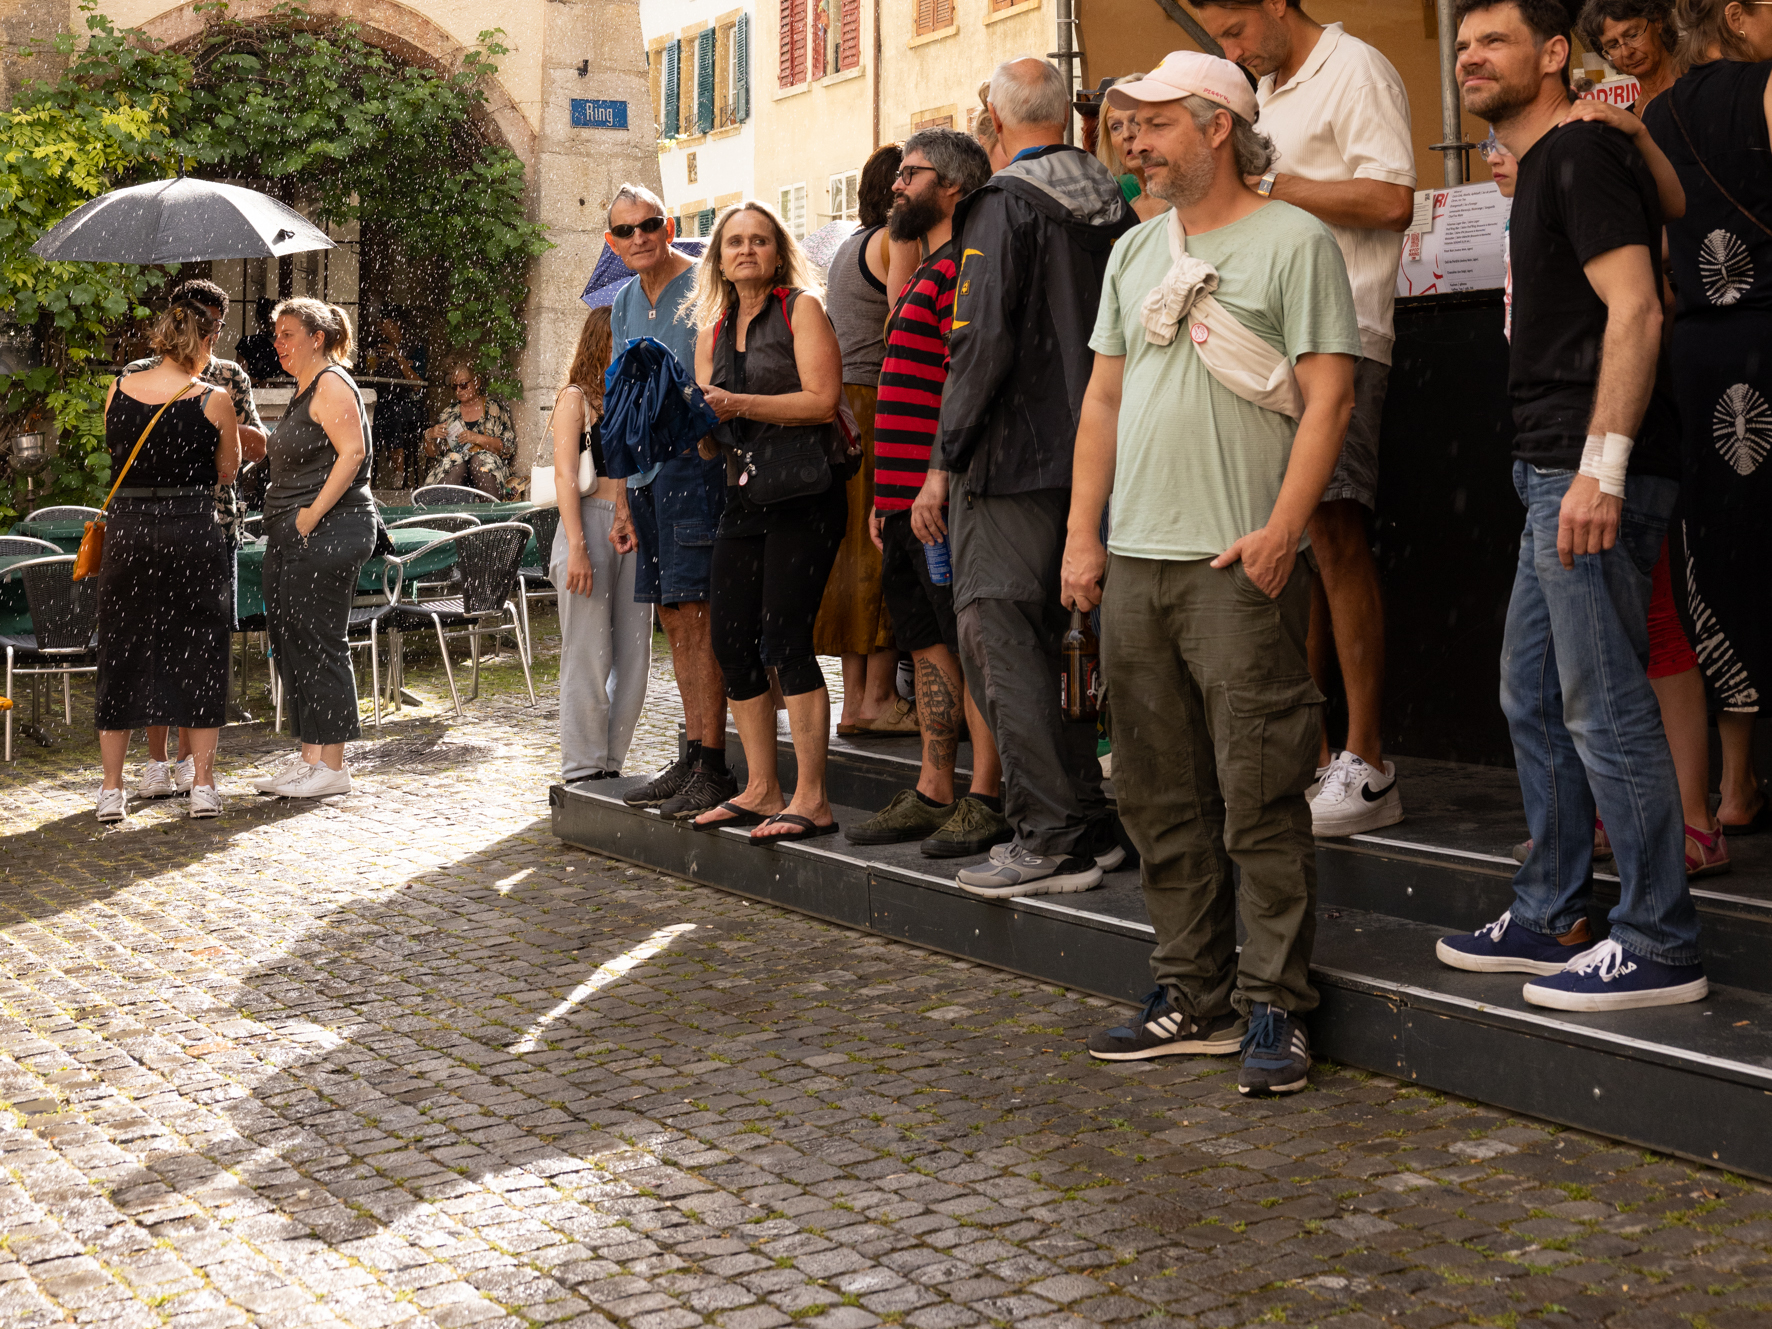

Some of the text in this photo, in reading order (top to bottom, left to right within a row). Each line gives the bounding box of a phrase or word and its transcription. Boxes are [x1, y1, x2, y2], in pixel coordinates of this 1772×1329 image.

[1580, 82, 1642, 105] OD'RIN
[586, 102, 614, 126] Ring
[1614, 961, 1638, 978] FILA
